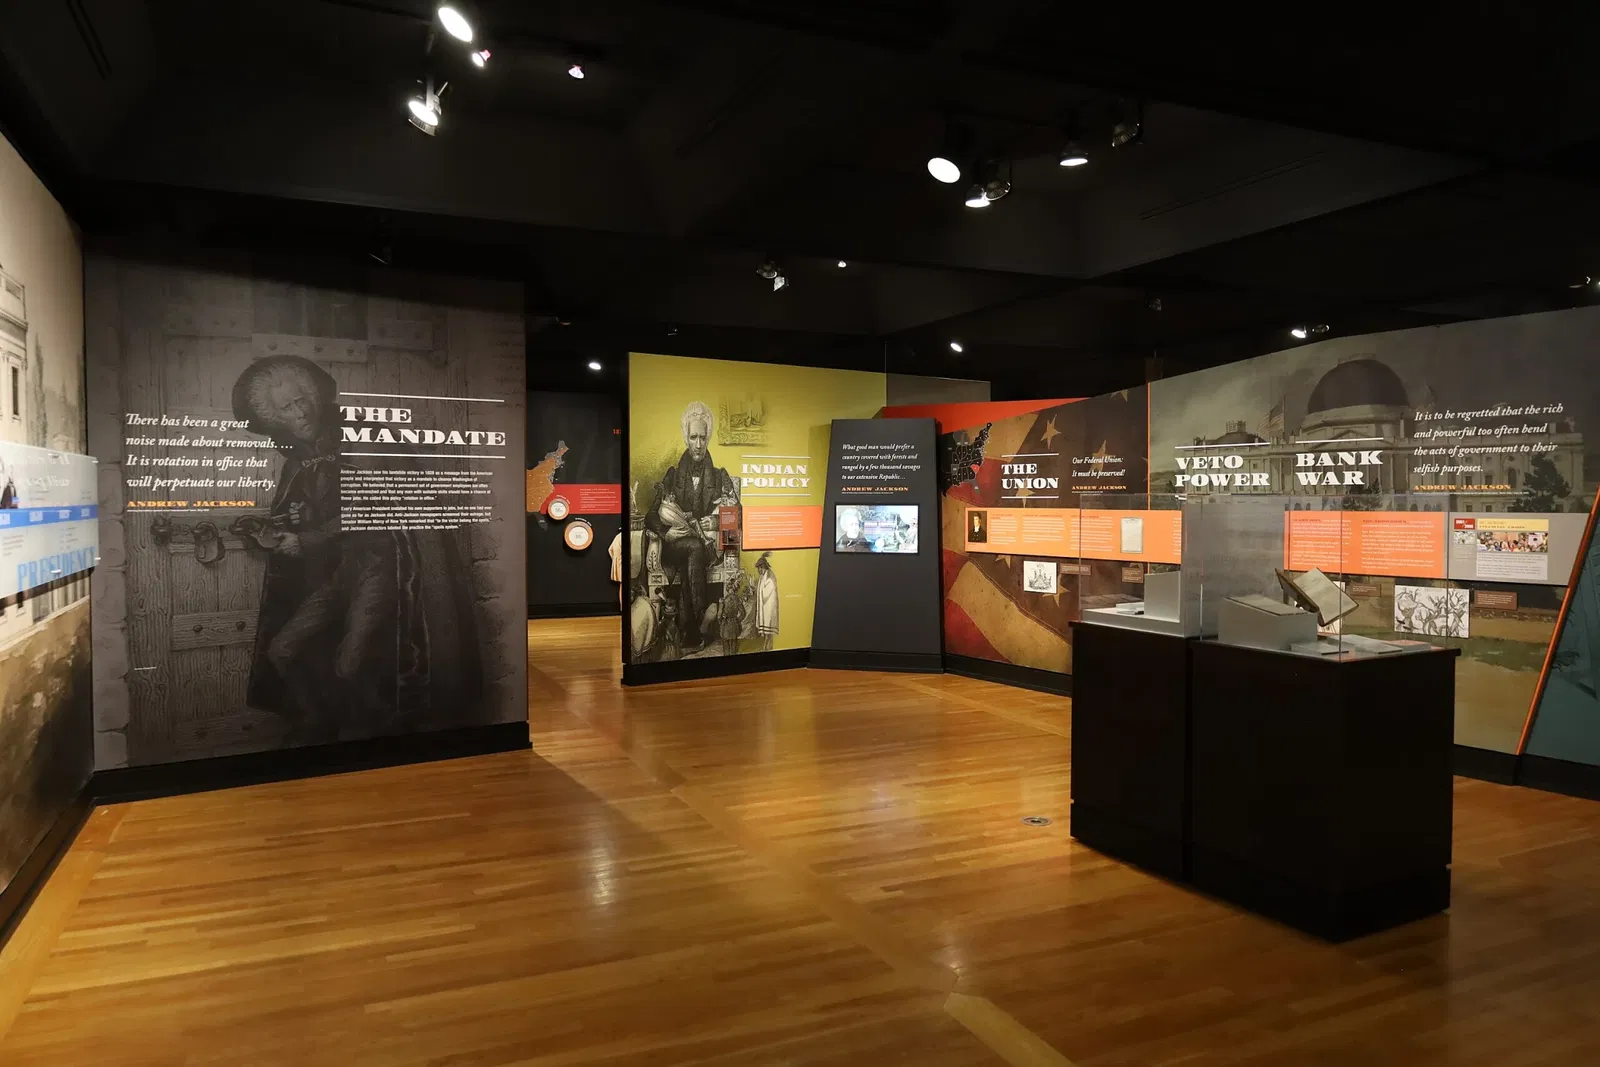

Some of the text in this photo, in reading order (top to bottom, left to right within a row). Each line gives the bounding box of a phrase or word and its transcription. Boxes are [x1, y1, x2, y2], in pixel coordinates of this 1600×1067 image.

[340, 406, 412, 424] THE
[1414, 412, 1423, 420] It
[1424, 411, 1432, 420] is
[1444, 410, 1455, 418] be
[1457, 406, 1500, 421] regretted
[1501, 406, 1522, 415] that
[1524, 405, 1540, 414] the
[1543, 403, 1563, 413] rich
[126, 413, 158, 425] There
[160, 414, 180, 426] has
[182, 415, 208, 427] been
[219, 420, 248, 431] great
[340, 426, 506, 446] MANDATE
[1414, 428, 1432, 438] and
[1431, 426, 1476, 441] powerful
[1494, 425, 1519, 438] often
[1521, 423, 1547, 433] bend
[126, 435, 155, 445] noise
[158, 435, 189, 446] made
[191, 436, 224, 447] about
[894, 443, 910, 451] prefer
[1414, 446, 1428, 455] the
[1448, 445, 1460, 457] of
[1462, 445, 1517, 457] government
[1532, 442, 1557, 451] their
[126, 454, 267, 470] It is rotation in office that
[1084, 456, 1104, 464] Federal
[1104, 455, 1124, 463] Union:
[1175, 455, 1243, 469] VETO
[1296, 450, 1382, 466] BANK
[741, 464, 807, 475] INDIAN
[1001, 464, 1036, 474] THE
[1097, 469, 1125, 478] preserved!
[1413, 464, 1483, 476] selfish purposes.
[127, 476, 152, 486] will
[152, 478, 214, 491] perpetuate
[237, 476, 275, 491] liberty.
[741, 477, 810, 488] POLICY
[1002, 477, 1058, 490] UNION
[1175, 473, 1269, 486] POWER
[1296, 471, 1363, 485] WAR
